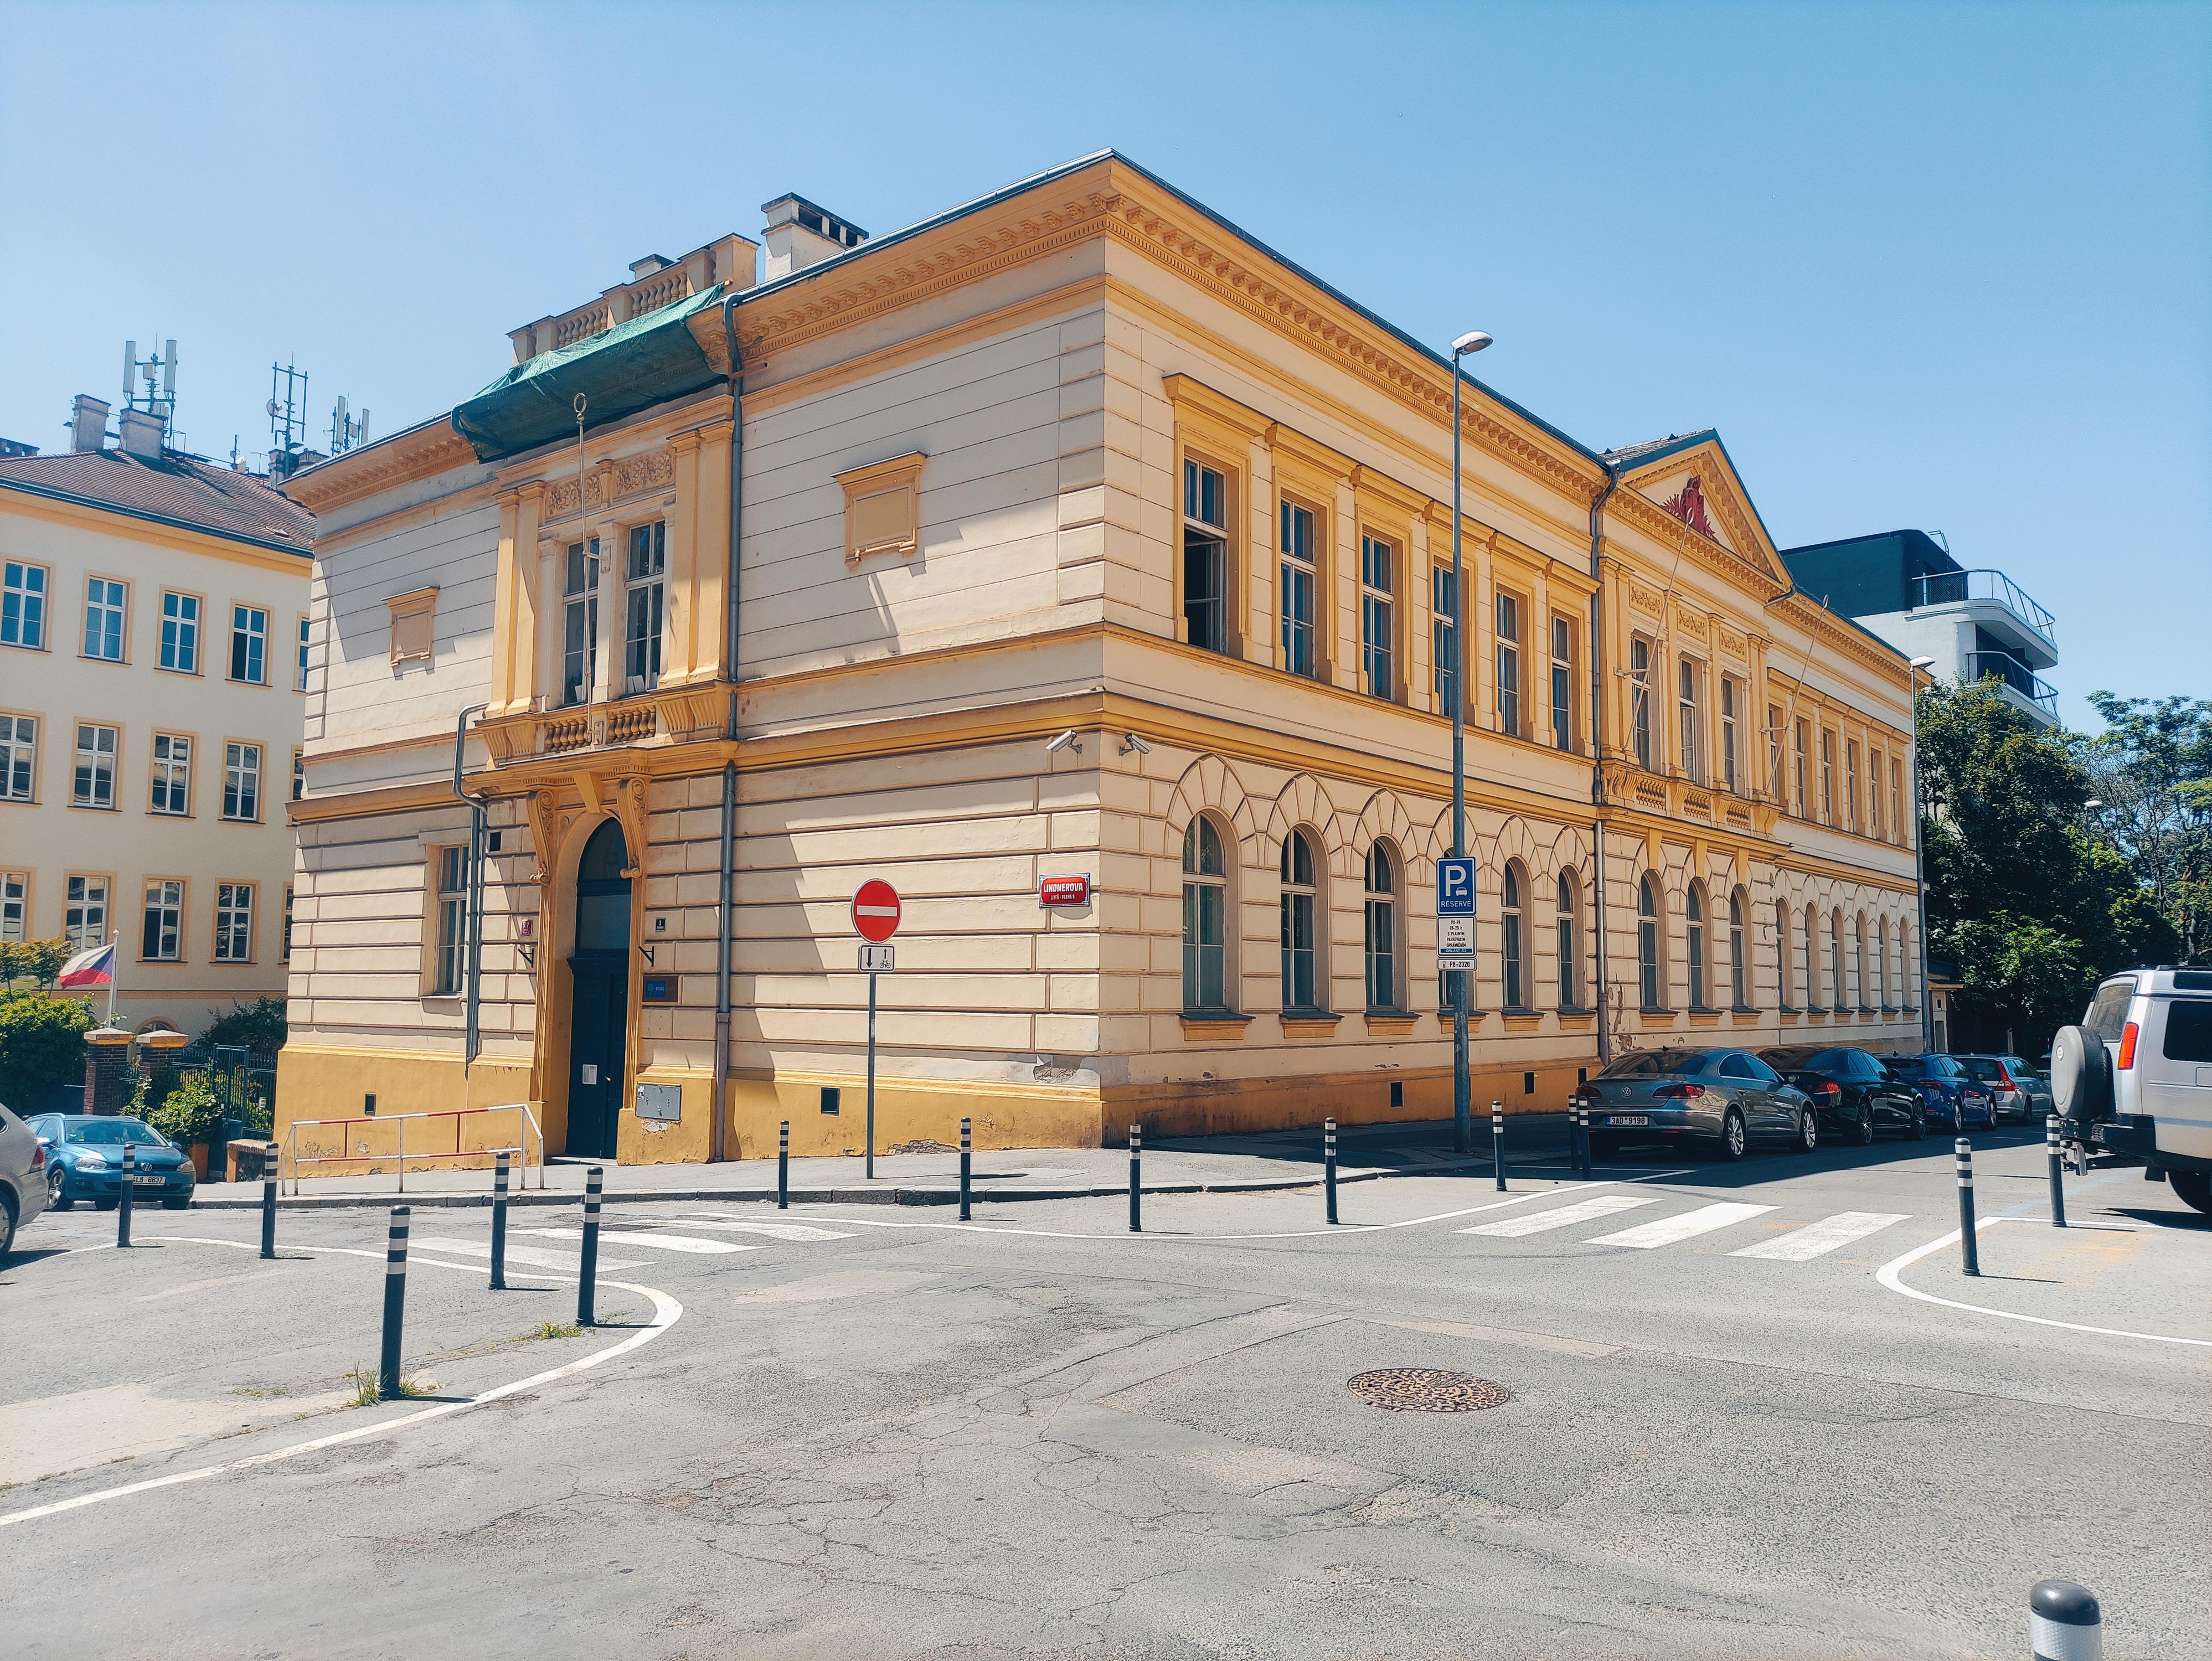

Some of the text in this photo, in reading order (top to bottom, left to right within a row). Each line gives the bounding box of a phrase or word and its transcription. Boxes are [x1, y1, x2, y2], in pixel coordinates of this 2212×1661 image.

[1445, 865, 1466, 896] P
[1043, 883, 1083, 893] LINDNEROVA
[1441, 899, 1472, 907] RÉSERVÉ
